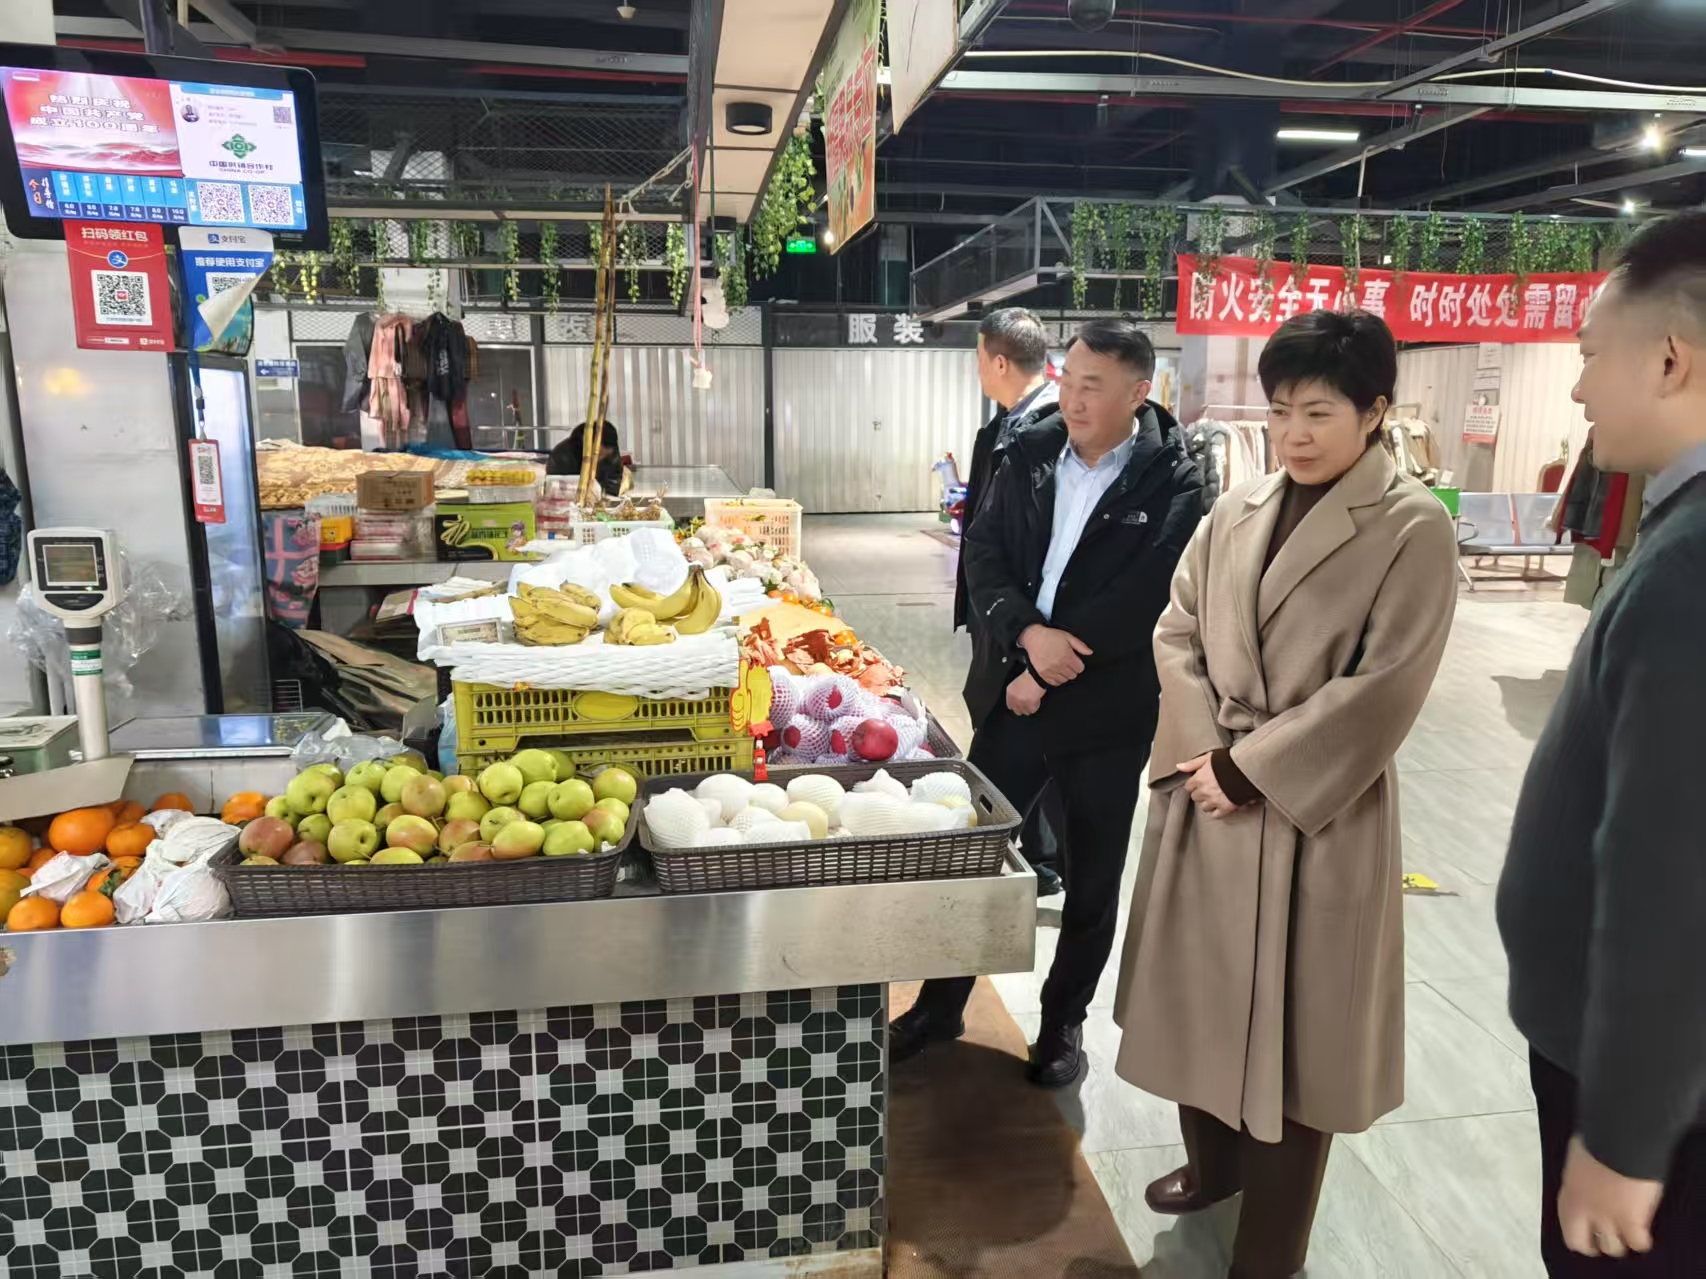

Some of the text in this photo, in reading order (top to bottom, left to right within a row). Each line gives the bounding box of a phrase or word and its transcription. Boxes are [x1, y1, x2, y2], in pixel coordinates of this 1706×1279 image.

[40, 105, 144, 121] 中国共产党
[30, 116, 160, 133] 成立100周年
[81, 227, 148, 242] 扫码领红包
[221, 234, 247, 243] 支付宝
[195, 256, 265, 267] 推荐使用支付宝
[848, 313, 925, 344] 服装
